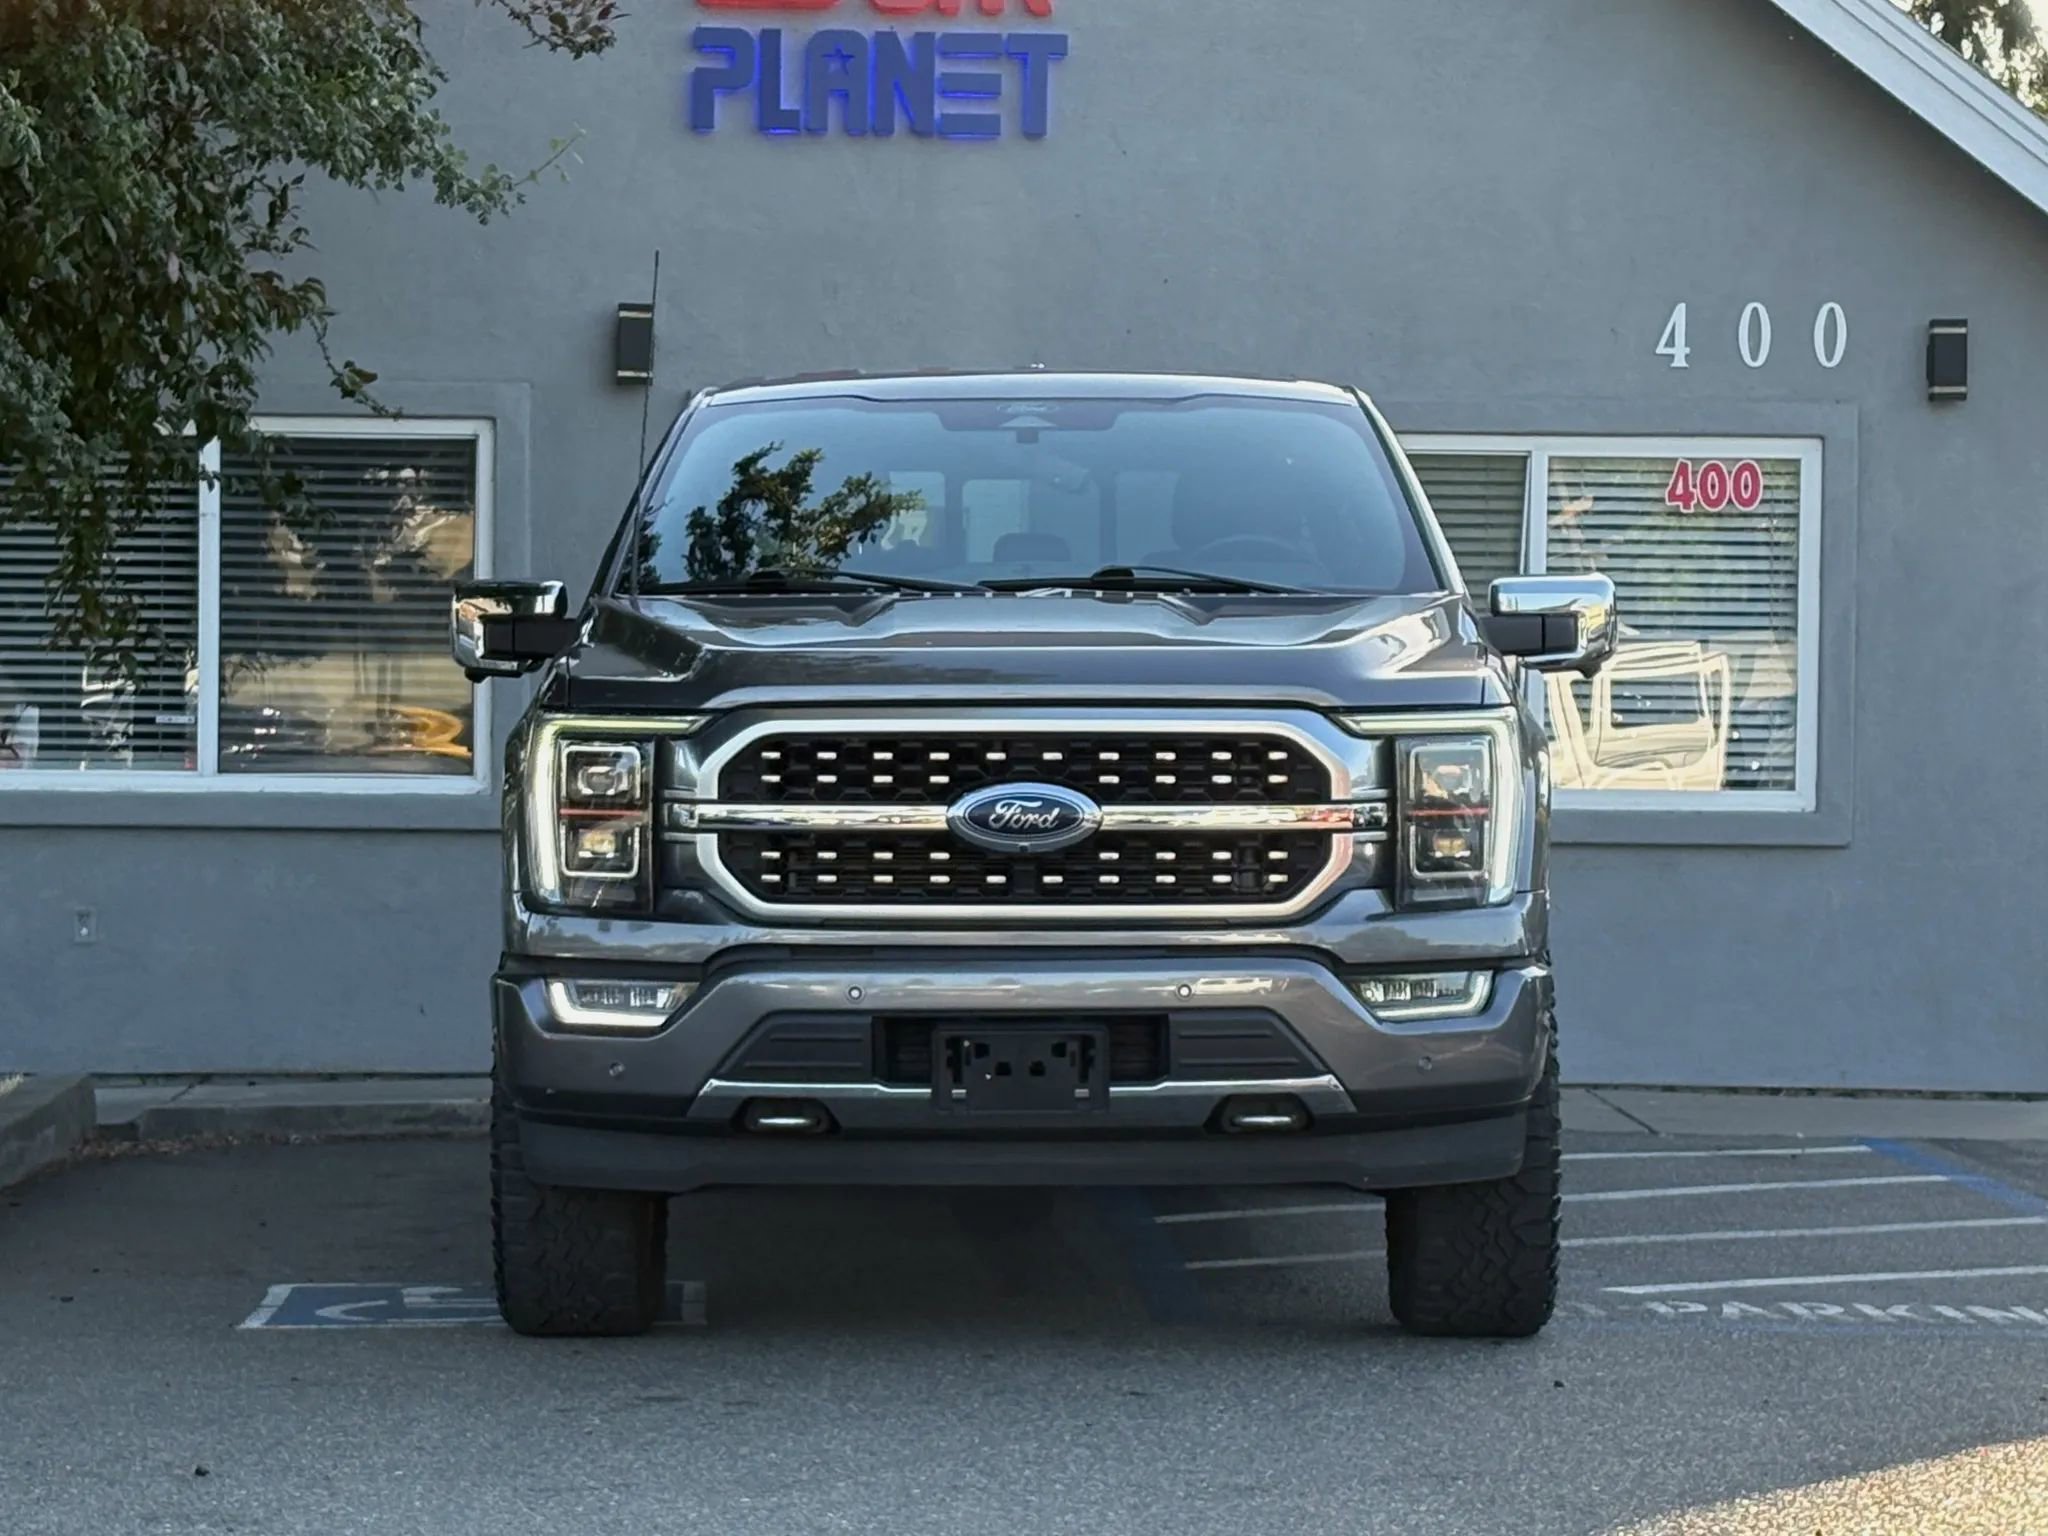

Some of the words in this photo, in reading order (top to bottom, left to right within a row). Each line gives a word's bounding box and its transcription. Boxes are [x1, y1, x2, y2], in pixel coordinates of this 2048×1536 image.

[692, 27, 1068, 137] PLANET
[1665, 458, 1763, 512] 400
[988, 799, 1060, 829] Ford
